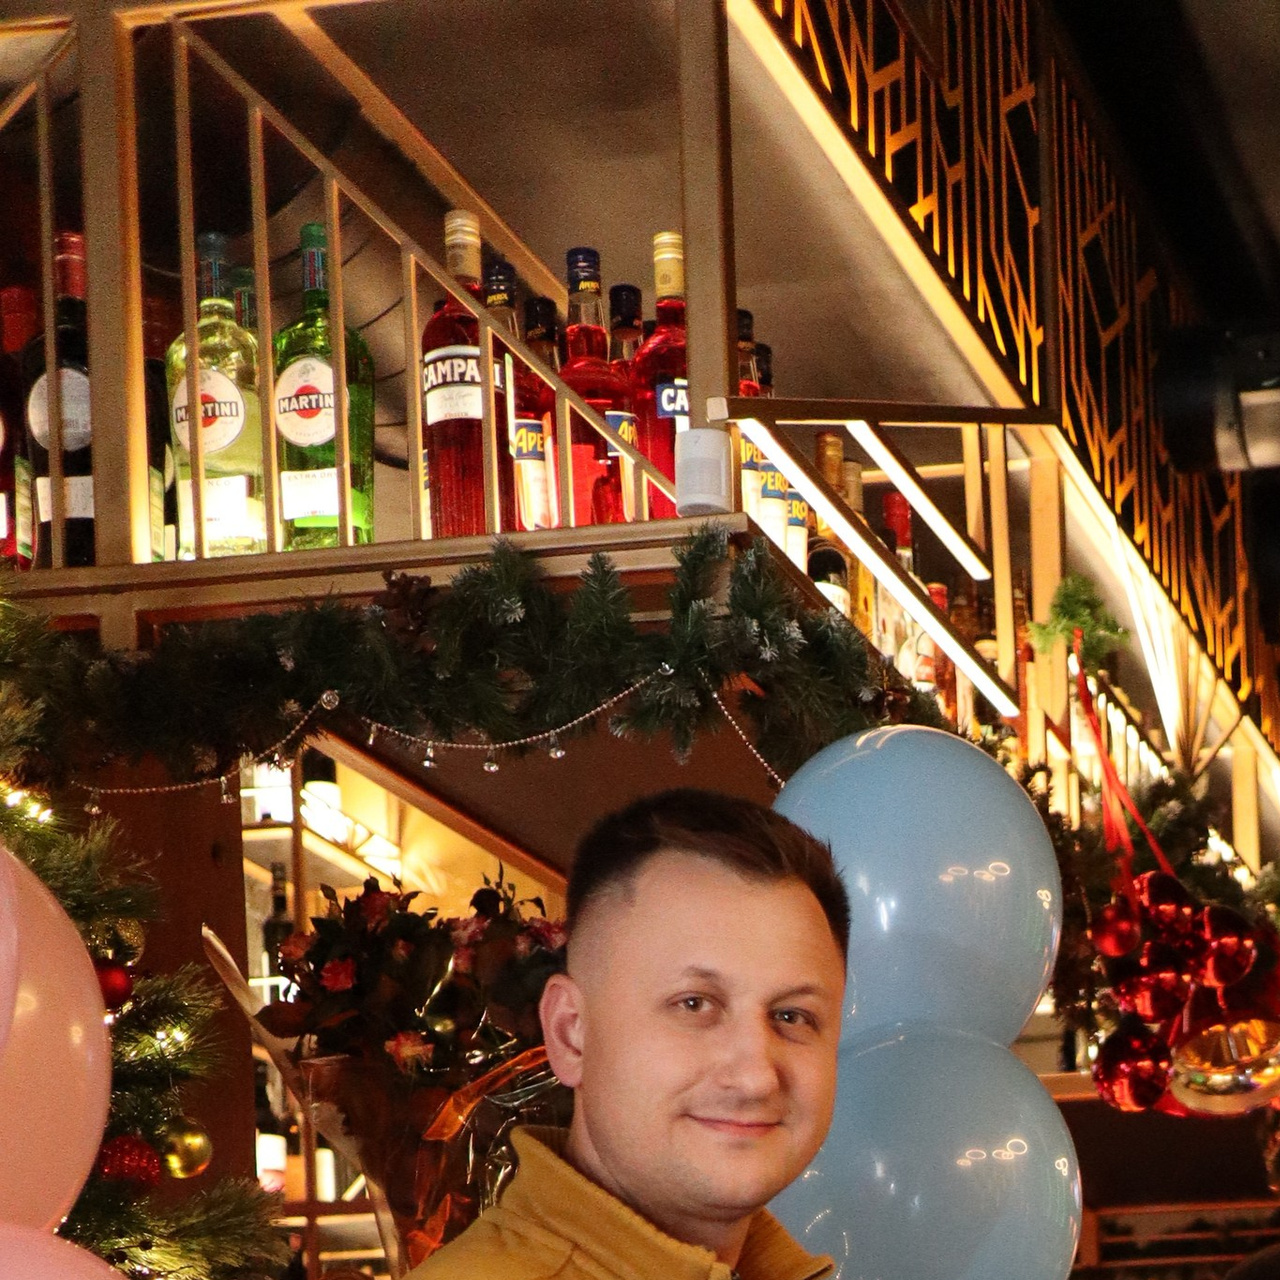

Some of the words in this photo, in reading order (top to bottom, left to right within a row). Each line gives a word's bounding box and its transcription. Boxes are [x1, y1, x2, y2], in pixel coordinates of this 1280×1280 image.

[423, 359, 502, 391] CAMPAI
[176, 402, 238, 421] MTINI
[280, 393, 335, 414] MARTIN
